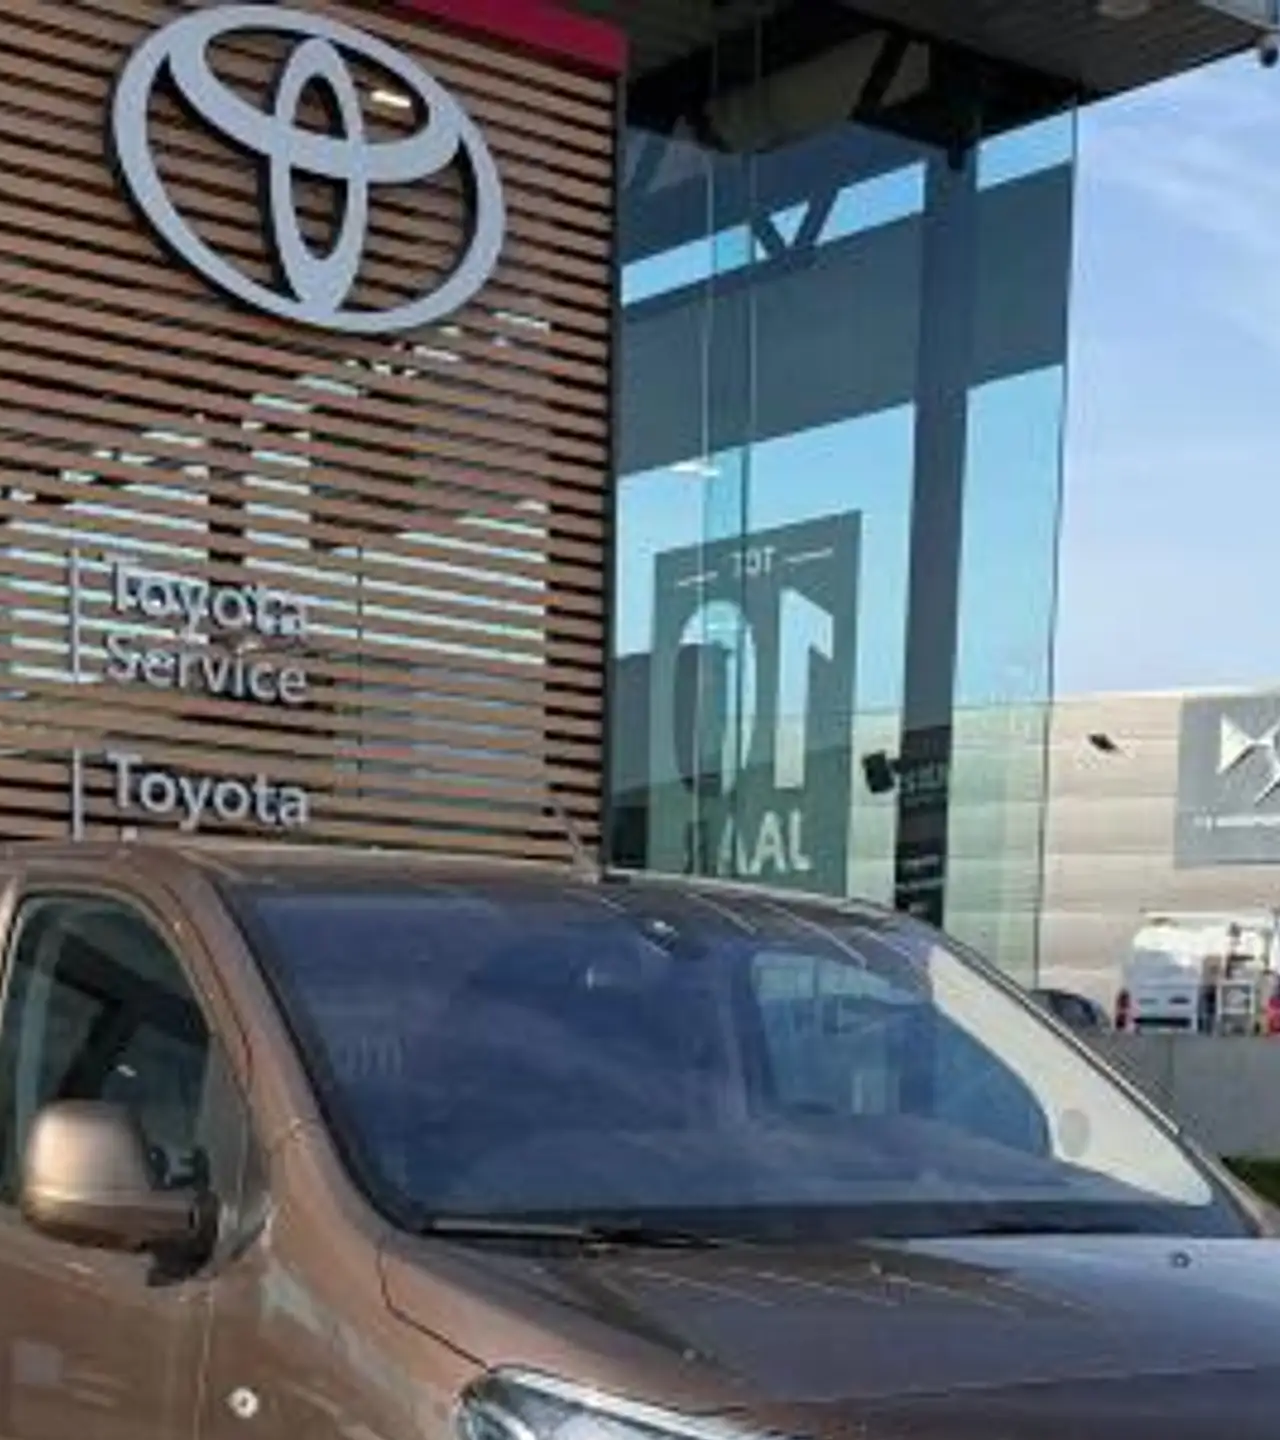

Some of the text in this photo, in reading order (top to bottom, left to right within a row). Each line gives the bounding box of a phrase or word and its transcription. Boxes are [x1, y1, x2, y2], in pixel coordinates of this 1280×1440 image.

[106, 554, 310, 643] Toyota
[106, 632, 310, 704] Service
[106, 749, 310, 829] Toyota
